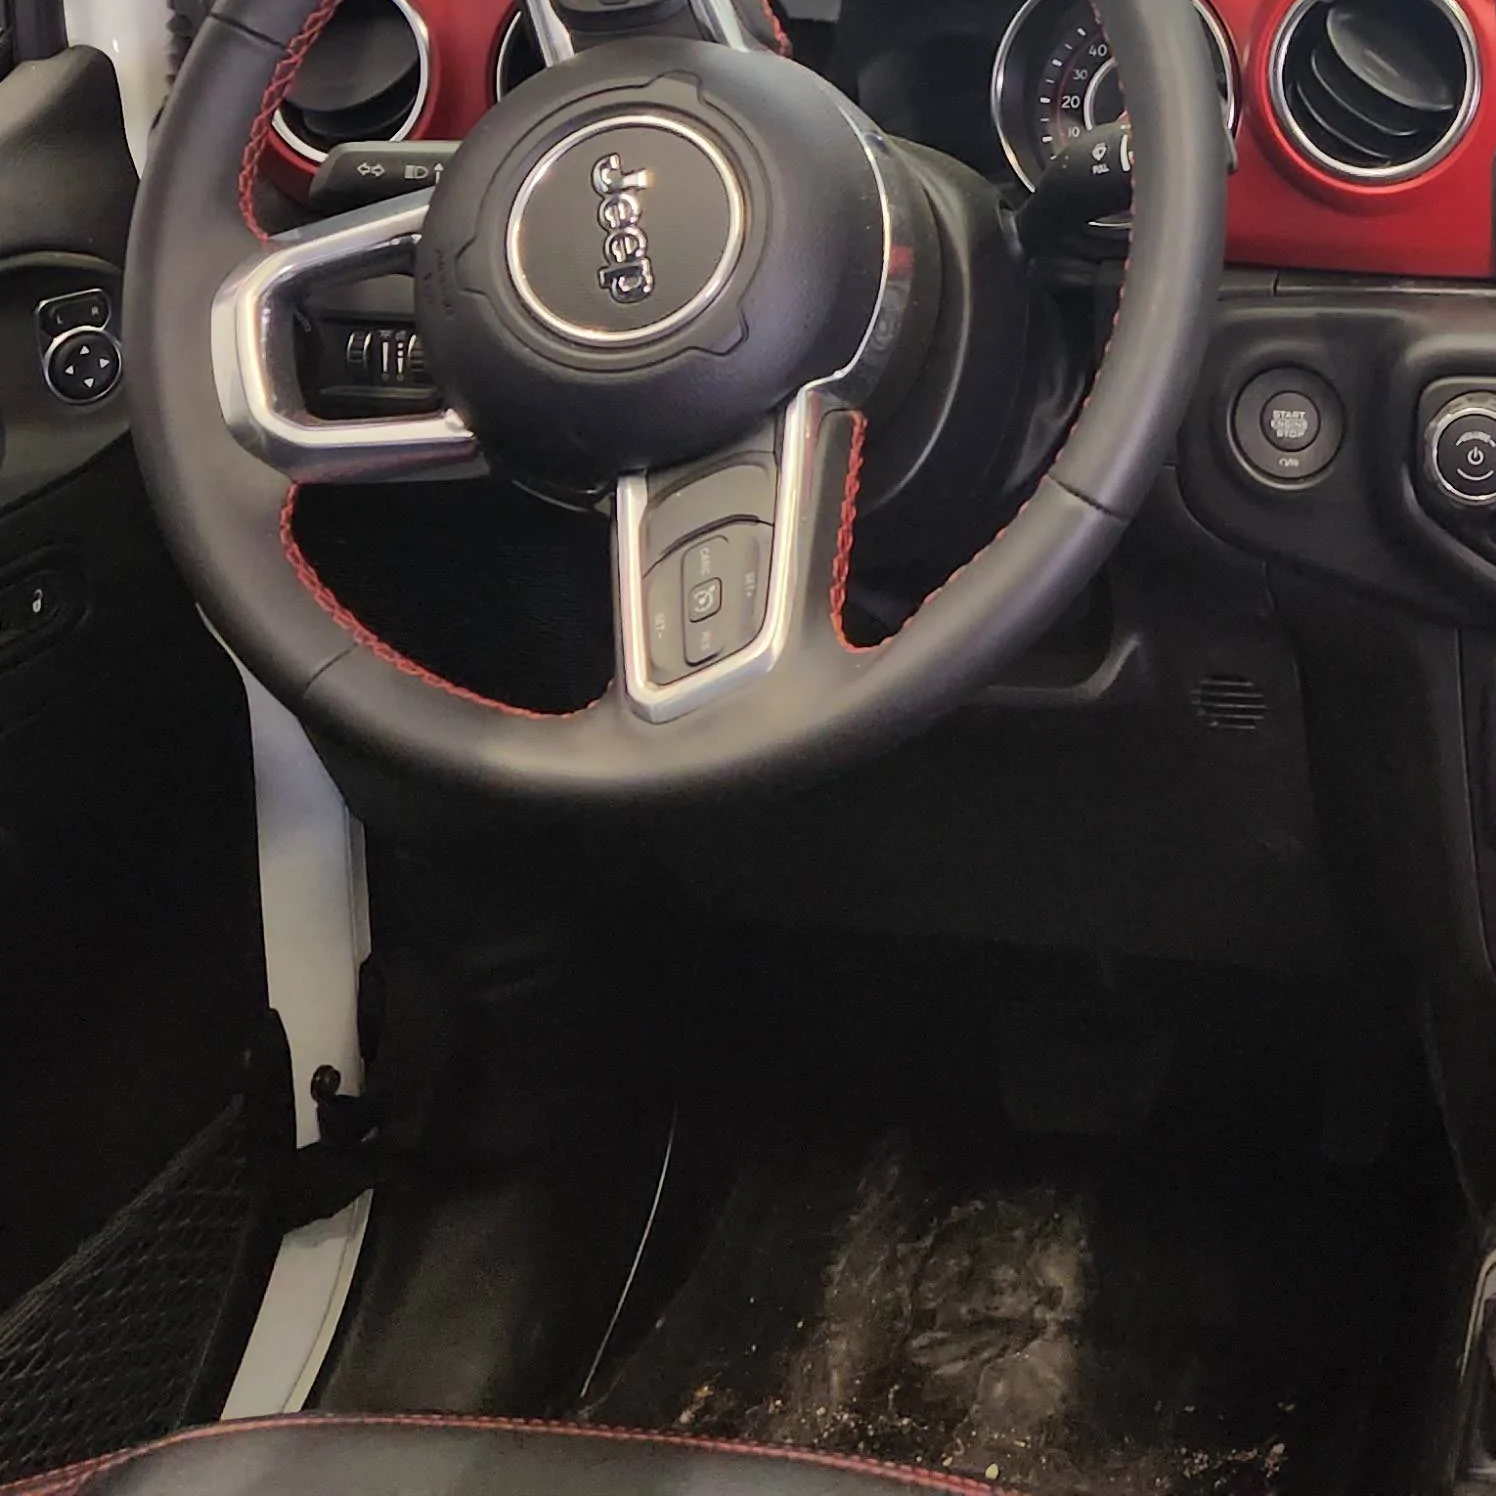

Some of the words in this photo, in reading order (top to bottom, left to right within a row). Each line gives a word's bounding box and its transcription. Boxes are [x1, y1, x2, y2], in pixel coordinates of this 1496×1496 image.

[1089, 44, 1108, 57] 40
[1073, 69, 1088, 81] 30
[1061, 95, 1081, 109] 20
[1067, 126, 1081, 138] 10
[591, 153, 655, 304] Jeep
[1272, 410, 1306, 419] START
